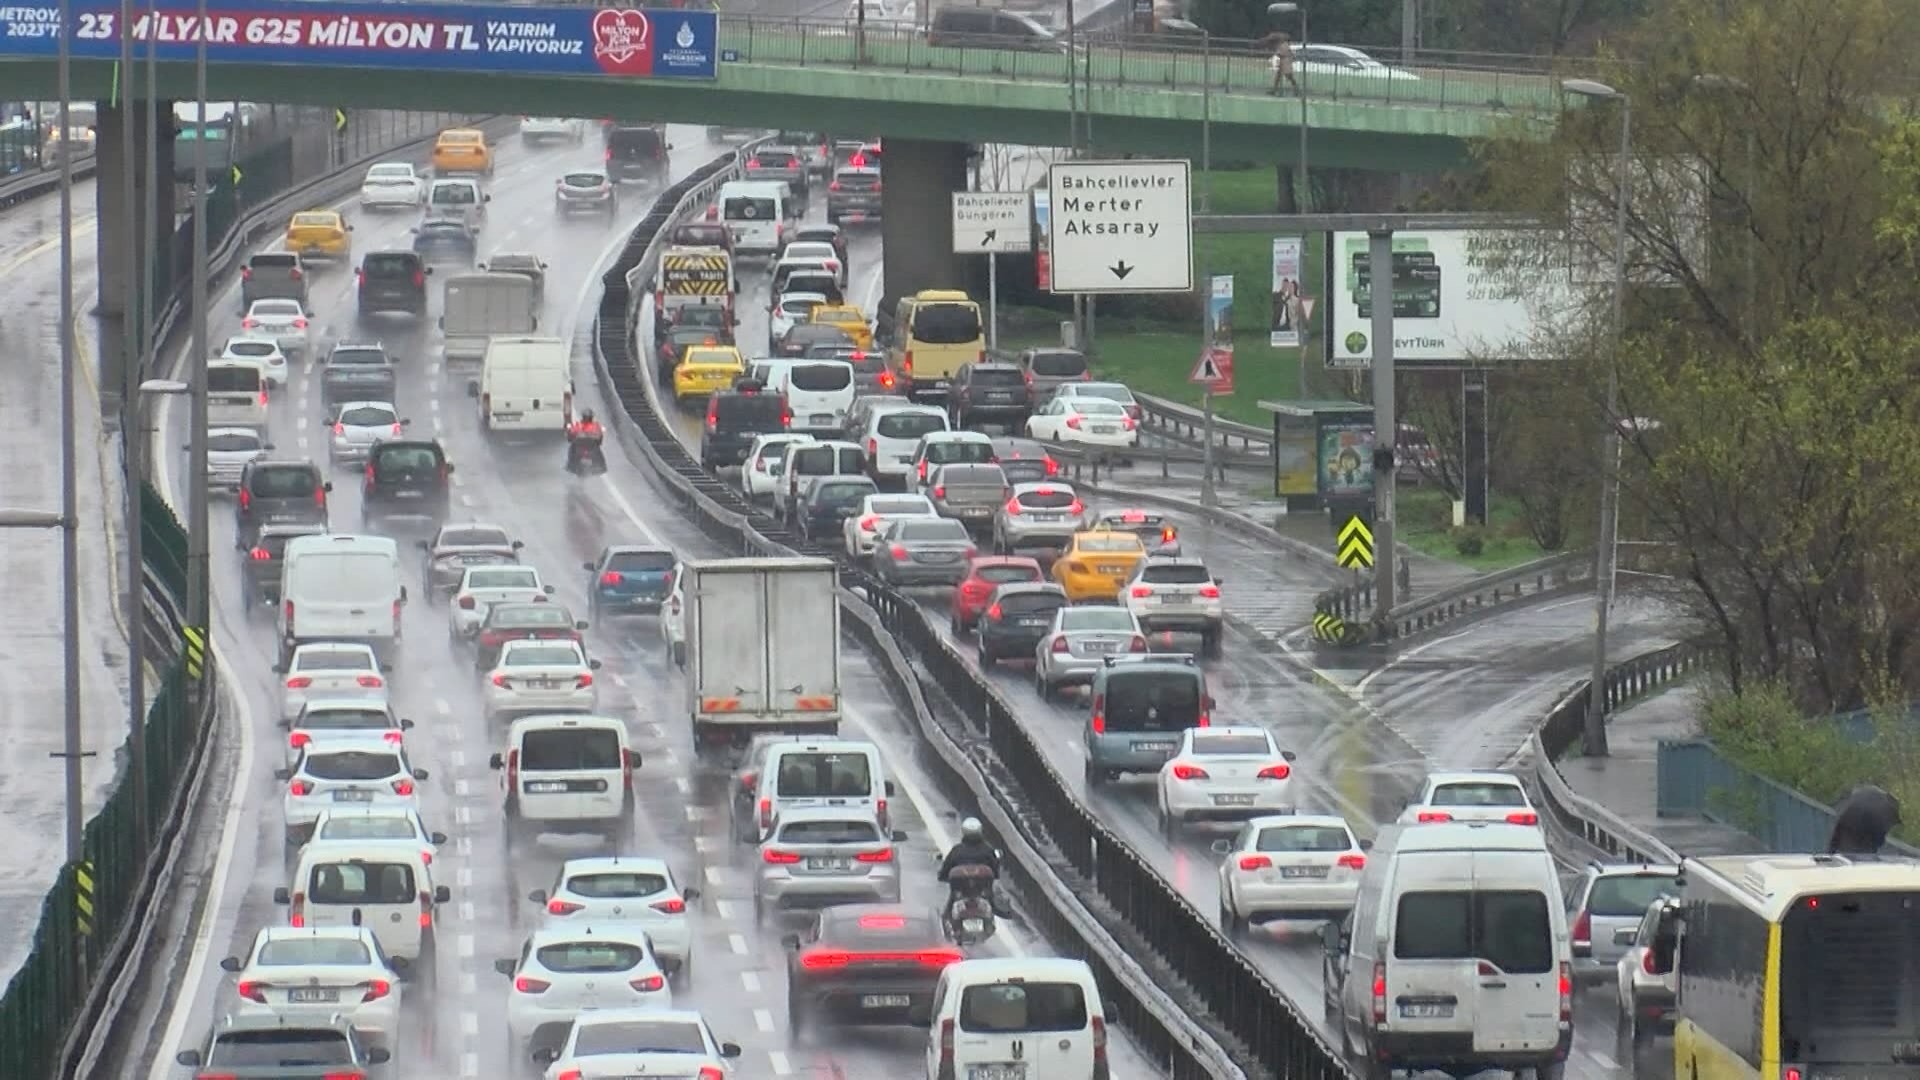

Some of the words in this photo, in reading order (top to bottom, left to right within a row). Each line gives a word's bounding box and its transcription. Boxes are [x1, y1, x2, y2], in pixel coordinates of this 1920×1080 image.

[77, 13, 114, 39] 23
[245, 18, 302, 44] 625
[443, 24, 479, 50] TL
[486, 21, 556, 37] YATIRIM
[486, 38, 583, 55] YAPIYORUZ
[1062, 175, 1175, 190] Bahçelievler
[957, 196, 1024, 208] Bahçelievler
[1063, 197, 1143, 212] Merter
[1064, 219, 1159, 238] Aksaray
